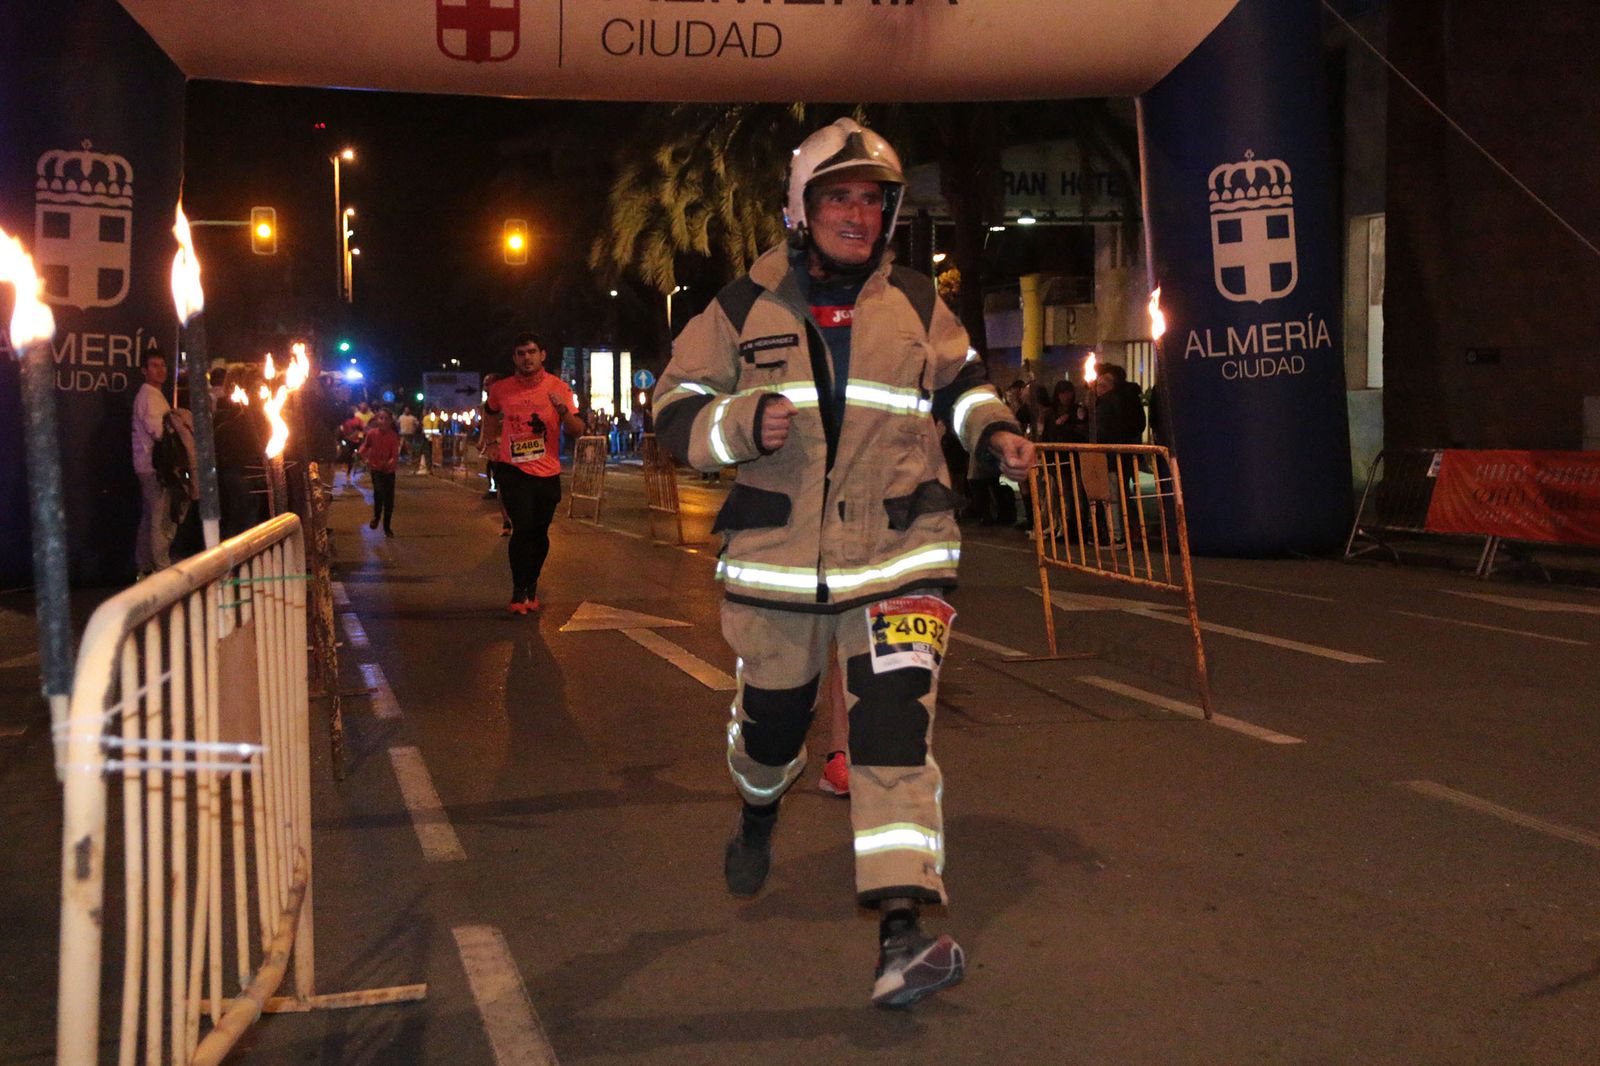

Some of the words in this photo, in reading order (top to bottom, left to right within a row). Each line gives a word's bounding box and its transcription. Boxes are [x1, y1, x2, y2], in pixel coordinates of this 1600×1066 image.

[601, 17, 783, 58] CIUDAD
[1002, 171, 1046, 196] RAN
[1184, 312, 1333, 360] ALMERÍA
[1221, 355, 1306, 380] CIUDAD
[57, 370, 129, 393] UDAD
[516, 440, 540, 451] 2486
[895, 616, 945, 645] 4032
